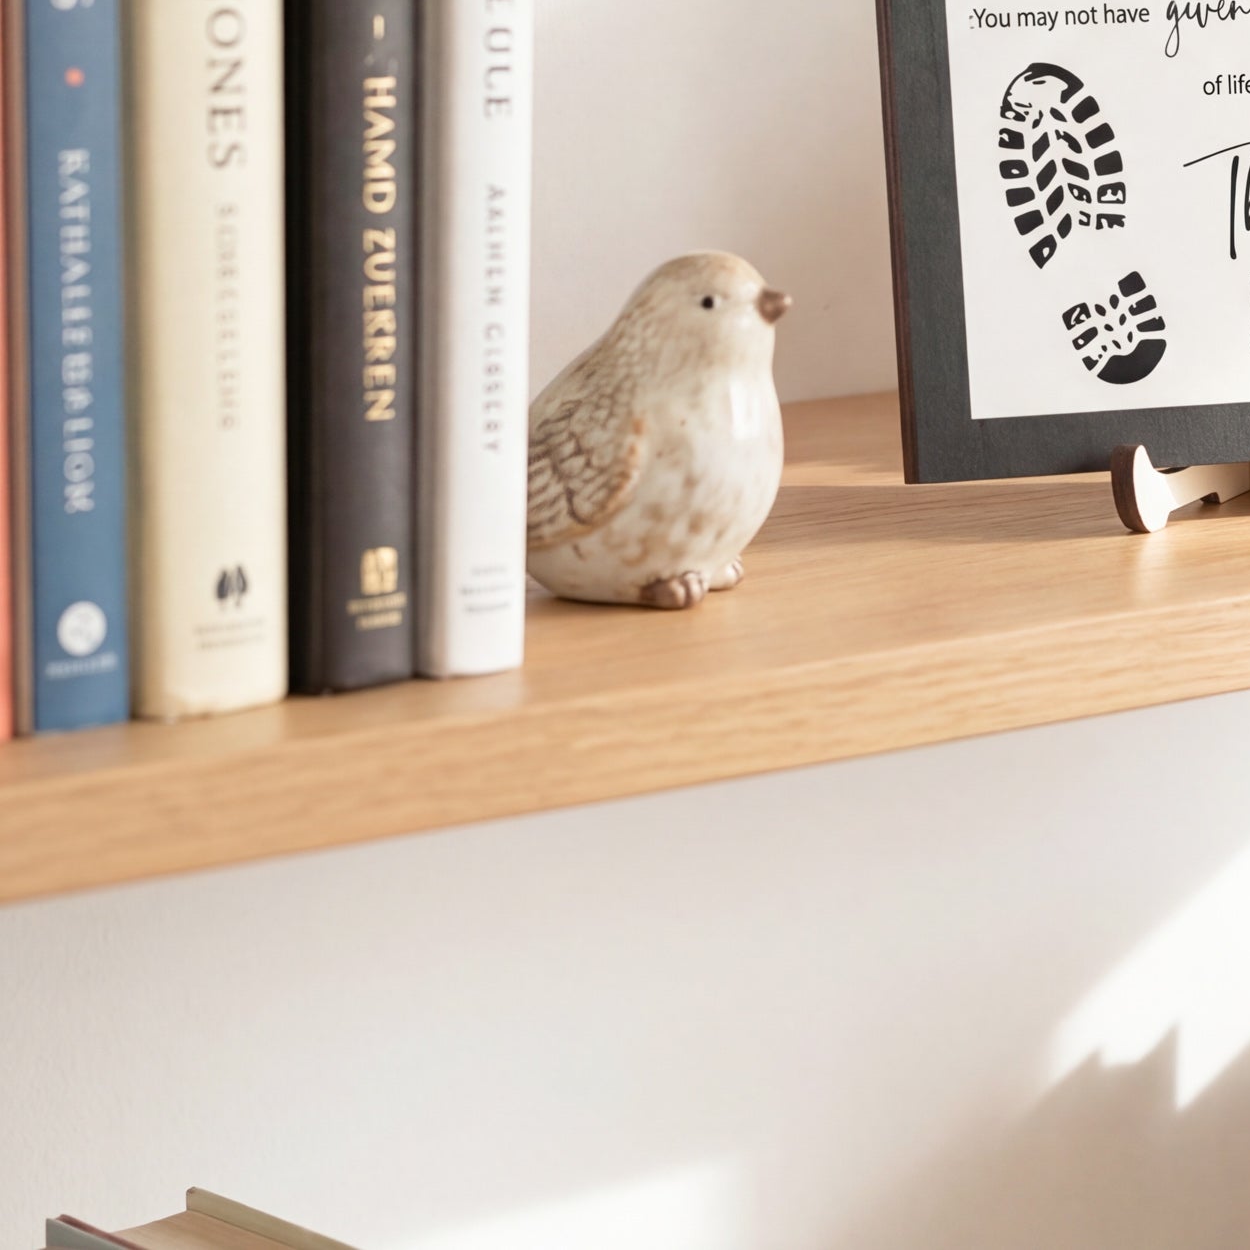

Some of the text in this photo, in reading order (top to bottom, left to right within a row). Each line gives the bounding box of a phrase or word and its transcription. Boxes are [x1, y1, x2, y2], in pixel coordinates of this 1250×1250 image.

[1017, 10, 1059, 32] may
[1064, 6, 1098, 26] not
[1103, 3, 1150, 24] have
[1202, 74, 1223, 96] of
[362, 76, 397, 214] HAMD
